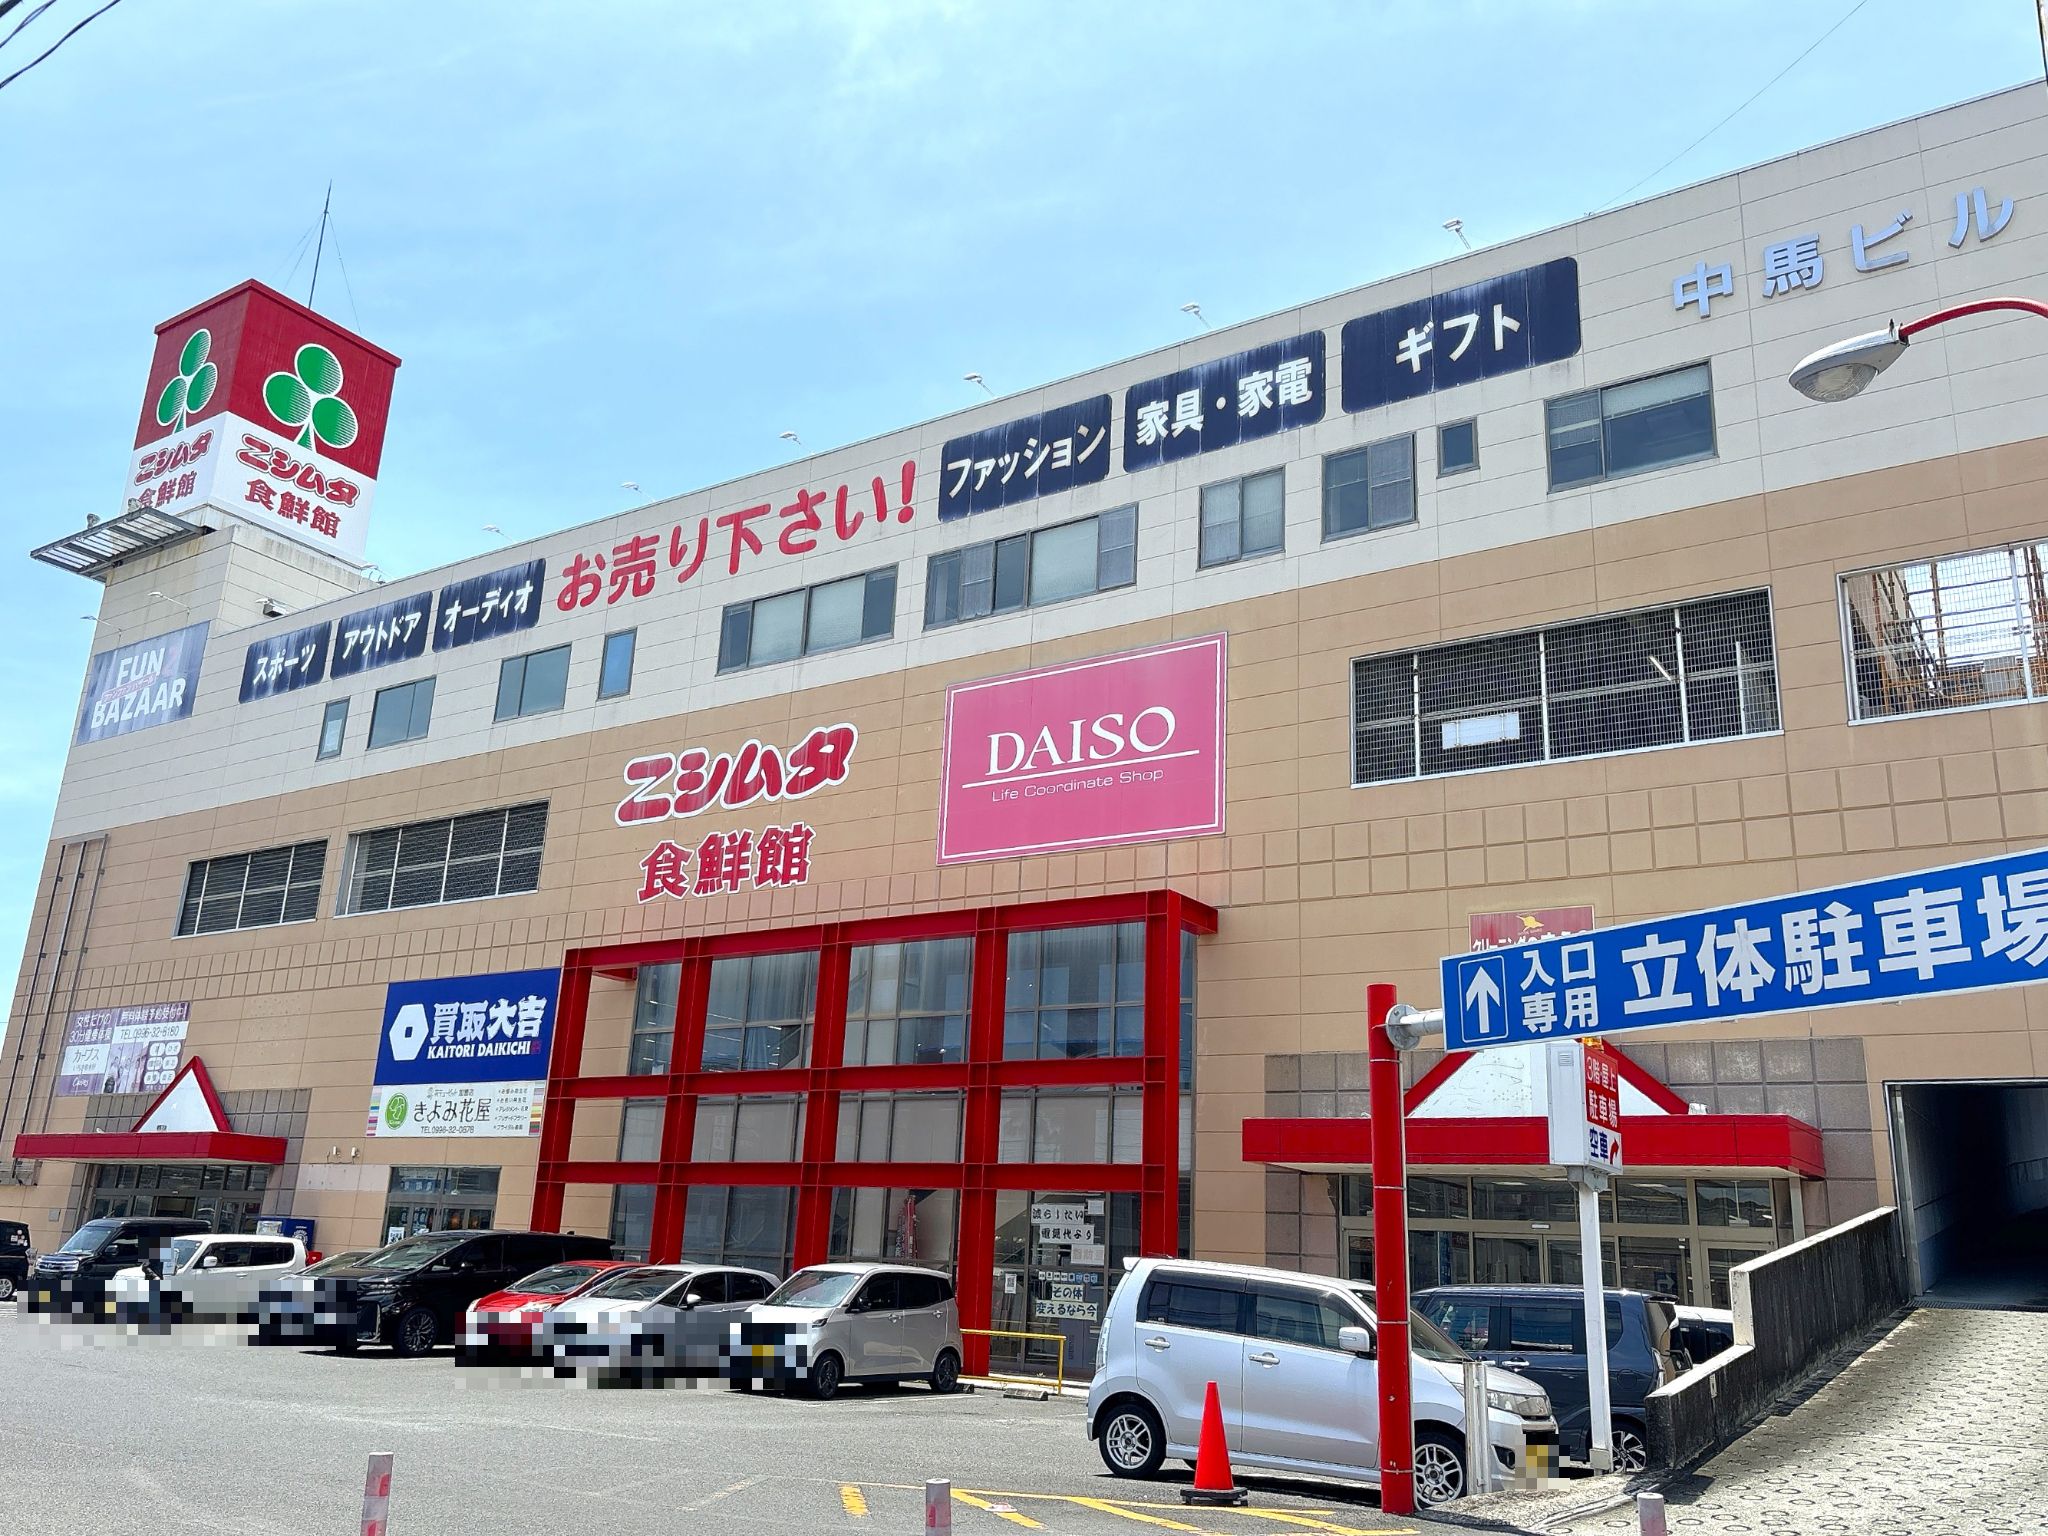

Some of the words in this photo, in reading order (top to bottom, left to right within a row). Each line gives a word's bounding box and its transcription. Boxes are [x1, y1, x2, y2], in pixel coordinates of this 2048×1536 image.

[1671, 185, 2015, 319] 中馬ビル
[1395, 304, 1522, 374] ギフト
[1135, 356, 1314, 447] 家具・家電
[134, 429, 215, 486] ニシムタ
[235, 433, 361, 507] ニシムタ
[946, 424, 1107, 498] ファッション
[138, 470, 198, 509] 食鮮館
[244, 478, 343, 540] 食鮮館
[557, 460, 917, 613] お売り下さい!
[443, 580, 534, 632] オーディオ
[343, 610, 423, 660] アウトドア
[252, 640, 317, 686] スポーツ
[91, 678, 187, 729] BAZAAR
[985, 706, 1177, 776] DAISO
[615, 722, 859, 827] ニシムタ
[992, 786, 1019, 802] Life
[1024, 775, 1114, 798] Coordinate
[1119, 769, 1165, 784] Shop
[637, 821, 816, 903] 食鮮館
[1520, 940, 1596, 991] 入口
[1621, 868, 2048, 1015] 立体駐車場
[429, 995, 548, 1044] 買取大吉
[1521, 984, 1599, 1034] 専用
[73, 1048, 99, 1063] カーブス
[427, 1043, 475, 1060] KAITORI
[477, 1040, 531, 1057] DAIKICHI
[413, 1098, 492, 1123] きよみ花屋
[1588, 1090, 1618, 1128] 駐車場
[1589, 1127, 1609, 1162] 空車
[1036, 1302, 1097, 1318] 変えるなら今
[1053, 1286, 1083, 1300] その体
